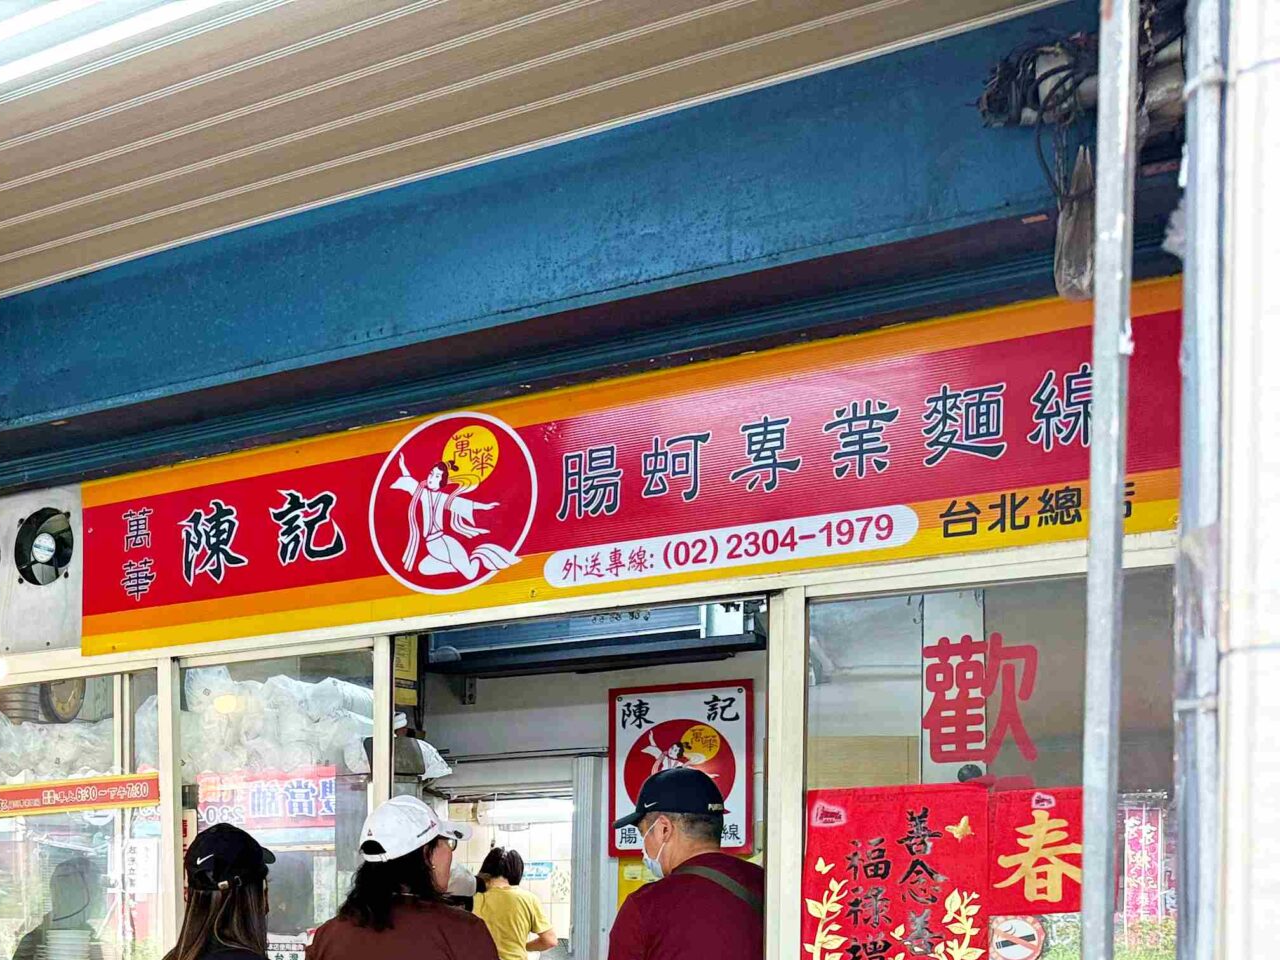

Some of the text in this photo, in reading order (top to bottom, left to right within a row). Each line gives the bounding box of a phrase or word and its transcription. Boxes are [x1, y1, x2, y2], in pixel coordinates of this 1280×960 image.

[120, 506, 157, 602] 萬華
[177, 488, 348, 586] 陳記
[939, 482, 1135, 538] 台北總
[561, 547, 655, 582] 外送專線:
[921, 632, 1039, 790] 歡
[993, 809, 1082, 903] 春
